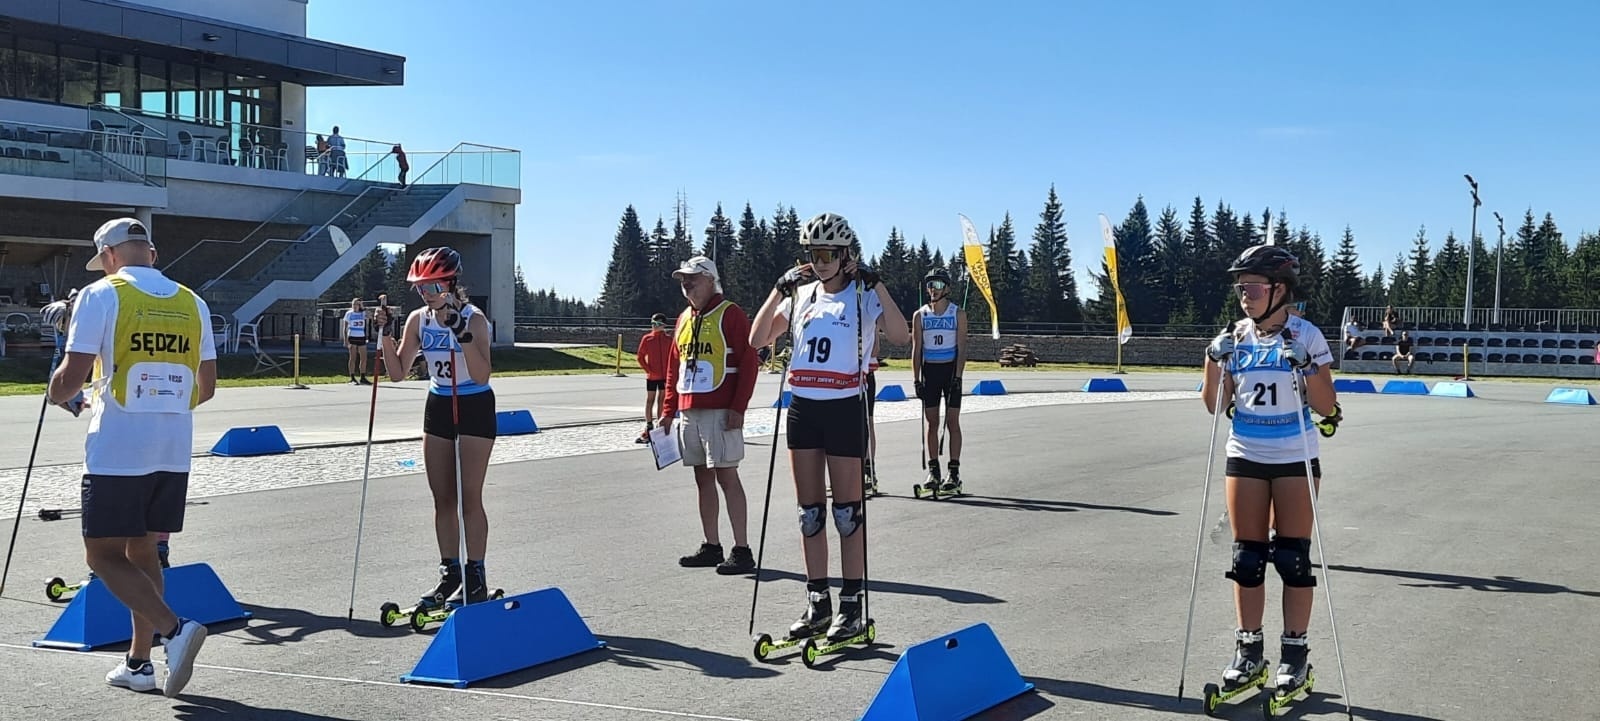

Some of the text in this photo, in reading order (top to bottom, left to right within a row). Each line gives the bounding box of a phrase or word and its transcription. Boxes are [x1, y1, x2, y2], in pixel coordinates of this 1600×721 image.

[924, 318, 954, 329] DZN
[130, 332, 191, 356] SĘDZIA
[421, 331, 450, 350] DZ
[933, 334, 943, 346] 10
[807, 336, 831, 364] 19
[434, 360, 452, 379] 23
[1253, 382, 1277, 406] 21
